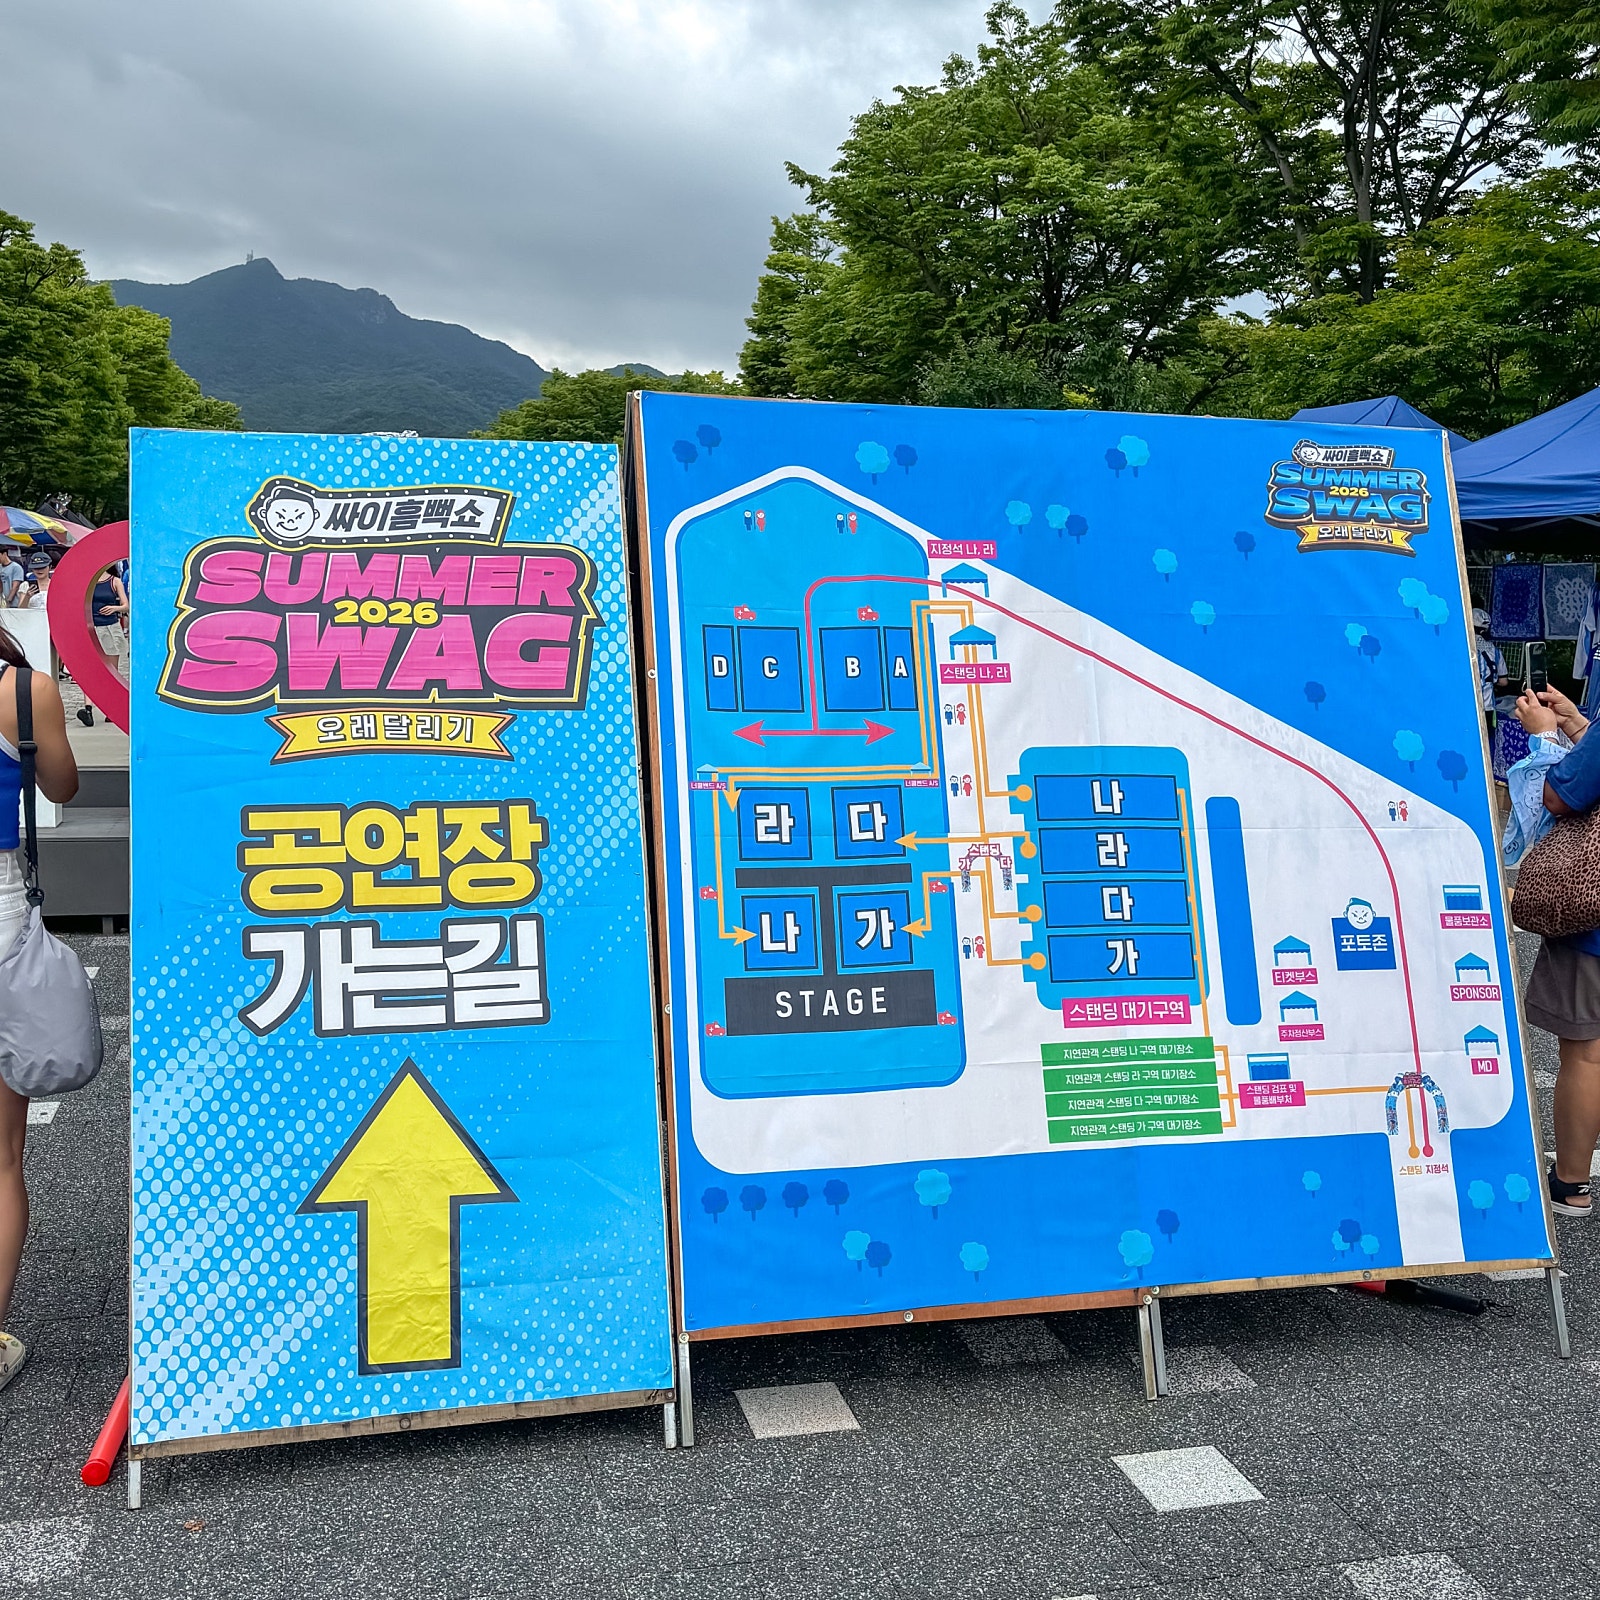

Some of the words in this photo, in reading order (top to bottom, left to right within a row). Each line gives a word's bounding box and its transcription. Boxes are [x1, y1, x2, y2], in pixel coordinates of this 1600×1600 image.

[1322, 449, 1384, 463] 싸이흠뻑쇼
[1274, 463, 1421, 490] SUMMER
[1329, 486, 1370, 497] 2026
[1272, 487, 1423, 521] SWAG
[322, 498, 485, 533] 싸이흠뻑쇼
[930, 543, 963, 555] 지정석
[966, 543, 981, 556] 나,
[982, 543, 995, 556] 라
[195, 550, 578, 607] SUMMER
[333, 600, 439, 624] 2026
[176, 610, 575, 693] SWAG
[713, 656, 728, 678] D
[762, 656, 779, 679] C
[845, 656, 860, 678] B
[893, 656, 908, 678] A
[943, 667, 976, 679] 스탠딩
[979, 667, 994, 680] 나,
[996, 666, 1009, 679] 라
[1091, 780, 1124, 814] 나
[754, 803, 795, 843] 라
[847, 802, 888, 841] 다
[244, 804, 543, 912] 공연장
[968, 843, 1000, 857] 스탠딩
[1096, 833, 1129, 868] 라
[959, 858, 971, 871] 가
[1000, 856, 1012, 869] 다
[1101, 886, 1134, 921] 다
[759, 911, 800, 952] 나
[855, 908, 895, 949] 가
[1445, 915, 1489, 927] 물품보관소
[1340, 934, 1388, 952] 포토존
[1106, 940, 1139, 975] 가
[245, 919, 544, 1031] 가는길
[1274, 970, 1316, 983] 티켓부스
[775, 987, 887, 1018] STAGE
[1452, 987, 1499, 1000] SPONSOR
[1069, 1004, 1118, 1022] 스탠딩
[1122, 1001, 1184, 1020] 대기구역
[1280, 1028, 1323, 1038] 주차정산부스
[1063, 1048, 1100, 1060] 지연관객
[1101, 1047, 1128, 1058] 스탠딩
[1129, 1046, 1139, 1055] 나
[1139, 1045, 1157, 1055] 구역
[1158, 1044, 1195, 1054] 대기장소
[1065, 1073, 1102, 1085] 지연관객
[1104, 1071, 1130, 1083] 스탠딩
[1131, 1071, 1141, 1080] 라
[1142, 1070, 1160, 1080] 구역
[1161, 1069, 1197, 1080] 대기장소
[1477, 1060, 1493, 1073] MD
[1246, 1085, 1270, 1095] 스탠딩
[1271, 1084, 1287, 1094] 검표
[1288, 1083, 1297, 1093] 및
[1068, 1099, 1105, 1110] 지연관객
[1106, 1097, 1133, 1108] 스탠딩
[1134, 1096, 1143, 1106] 다
[1144, 1095, 1162, 1105] 구역
[1163, 1094, 1200, 1105] 대기장소
[1253, 1095, 1293, 1106] 물품배부처
[1070, 1124, 1107, 1136] 지연관객
[1109, 1122, 1135, 1134] 스탠딩
[1137, 1121, 1147, 1132] 가
[1147, 1120, 1165, 1131] 구역
[1166, 1119, 1203, 1130] 대기장소
[1399, 1165, 1423, 1176] 스탠딩
[1425, 1163, 1450, 1175] 지정석
